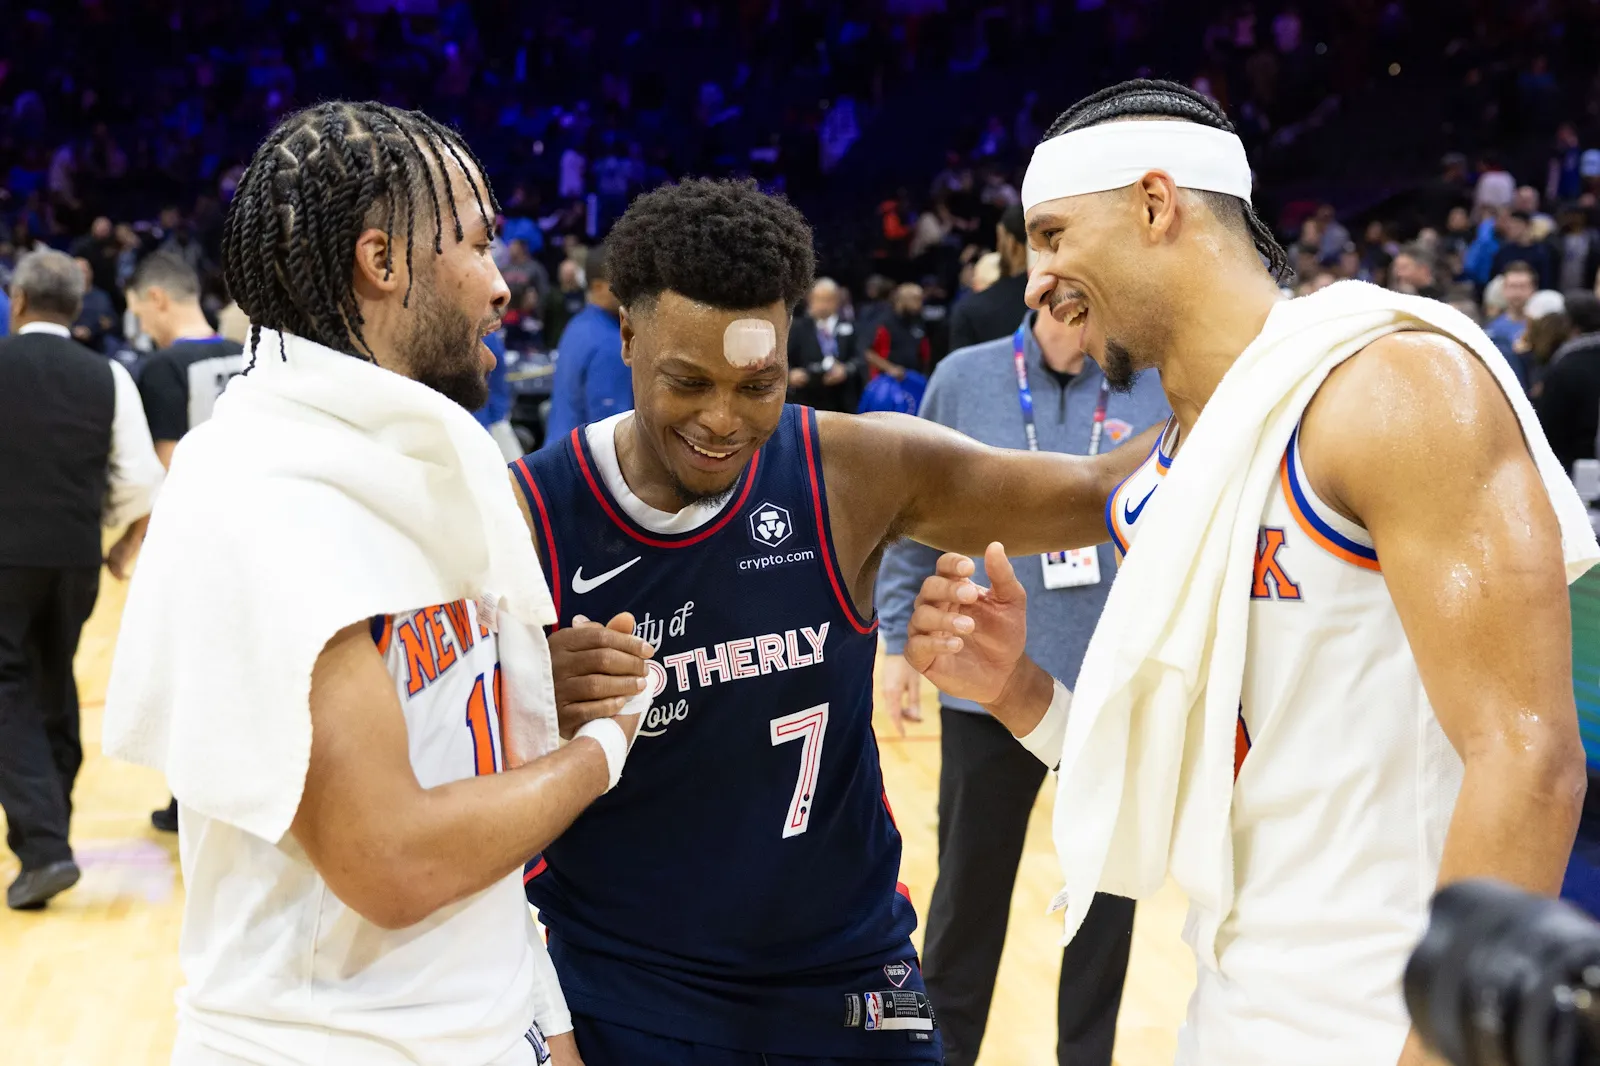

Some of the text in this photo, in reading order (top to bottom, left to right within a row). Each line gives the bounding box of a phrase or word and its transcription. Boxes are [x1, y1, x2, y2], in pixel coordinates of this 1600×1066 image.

[739, 550, 815, 570] crypto.com
[1250, 526, 1303, 601] K
[397, 594, 474, 698] NEW
[631, 600, 694, 650] ity of
[644, 621, 830, 698] OTHERLY
[466, 661, 506, 776] 1
[769, 702, 829, 839] 7
